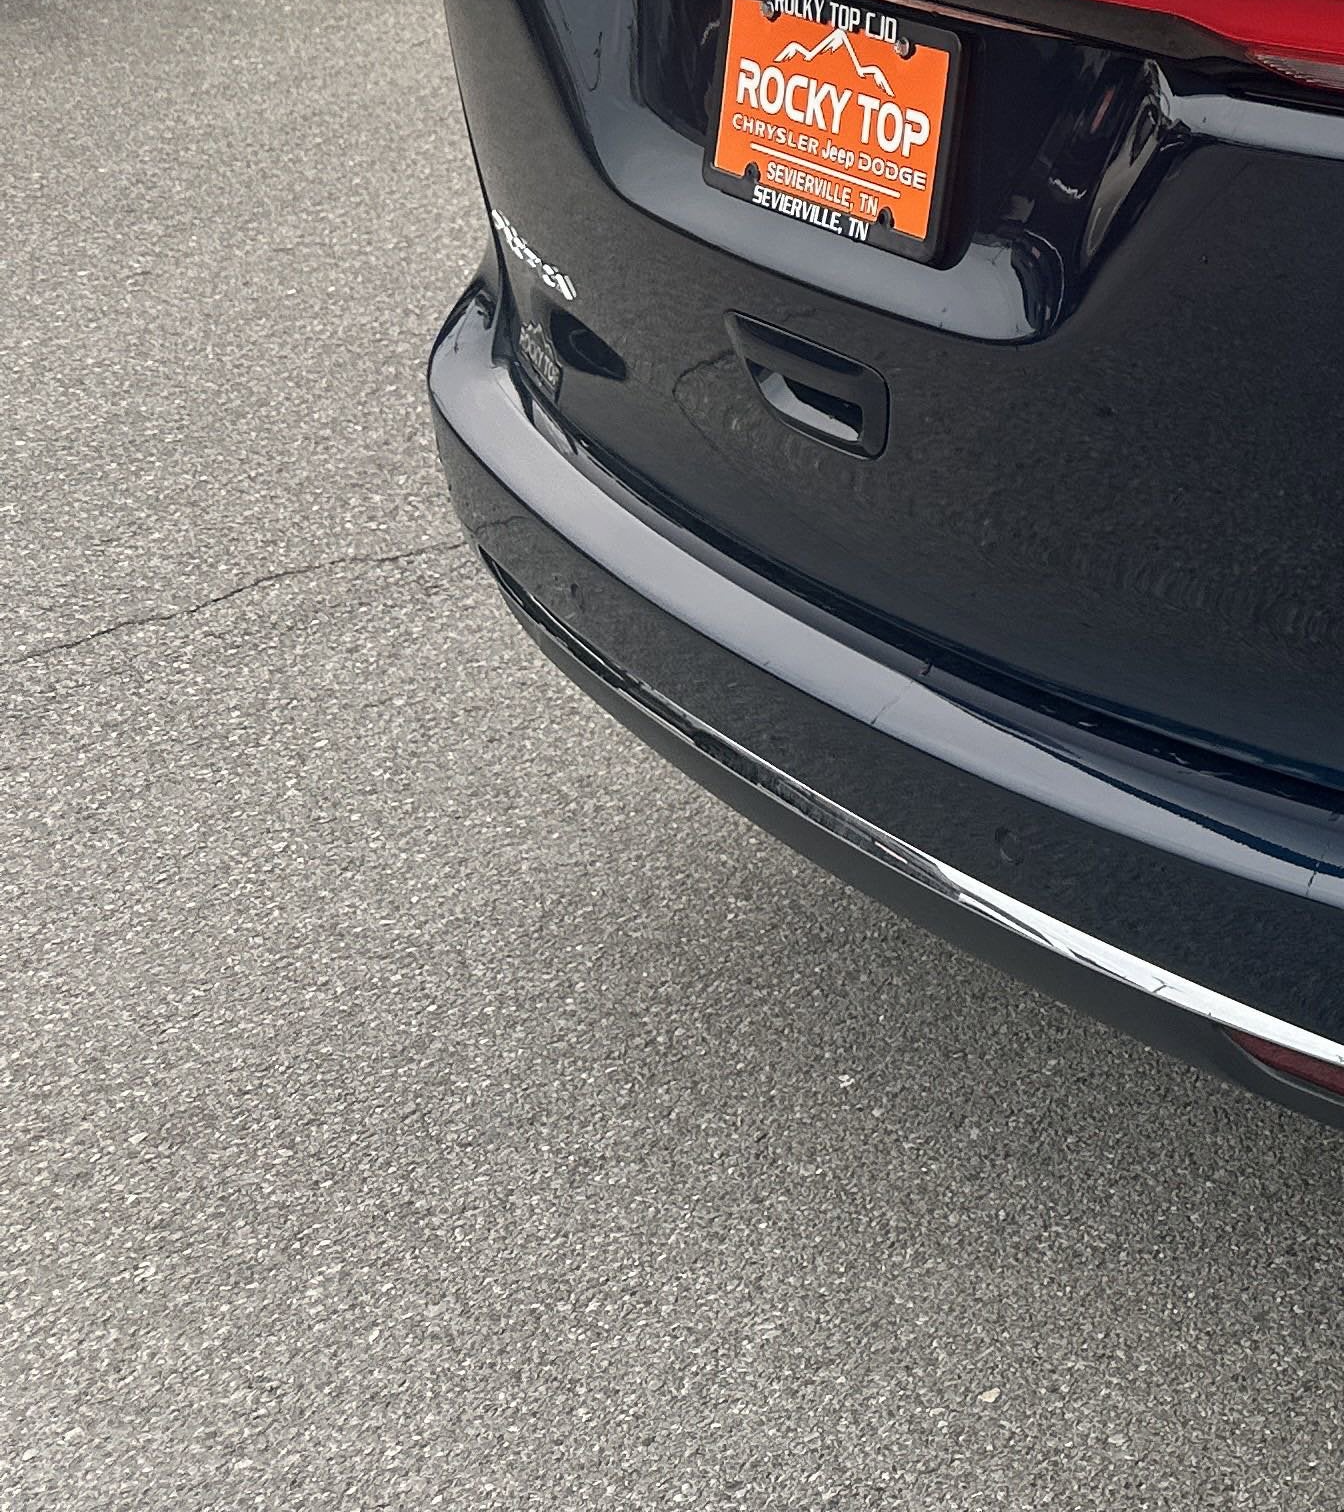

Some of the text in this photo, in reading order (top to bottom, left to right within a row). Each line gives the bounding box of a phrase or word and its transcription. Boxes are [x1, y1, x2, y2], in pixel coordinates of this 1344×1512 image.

[829, 2, 861, 31] TOP
[865, 12, 897, 44] CJD
[735, 57, 930, 158] ROCKY TOP
[732, 112, 927, 191] CHRYSLER Jeep DODGE
[752, 184, 870, 242] SEVIERVILLE, TN
[766, 160, 879, 217] SEVIERVILLE, TN
